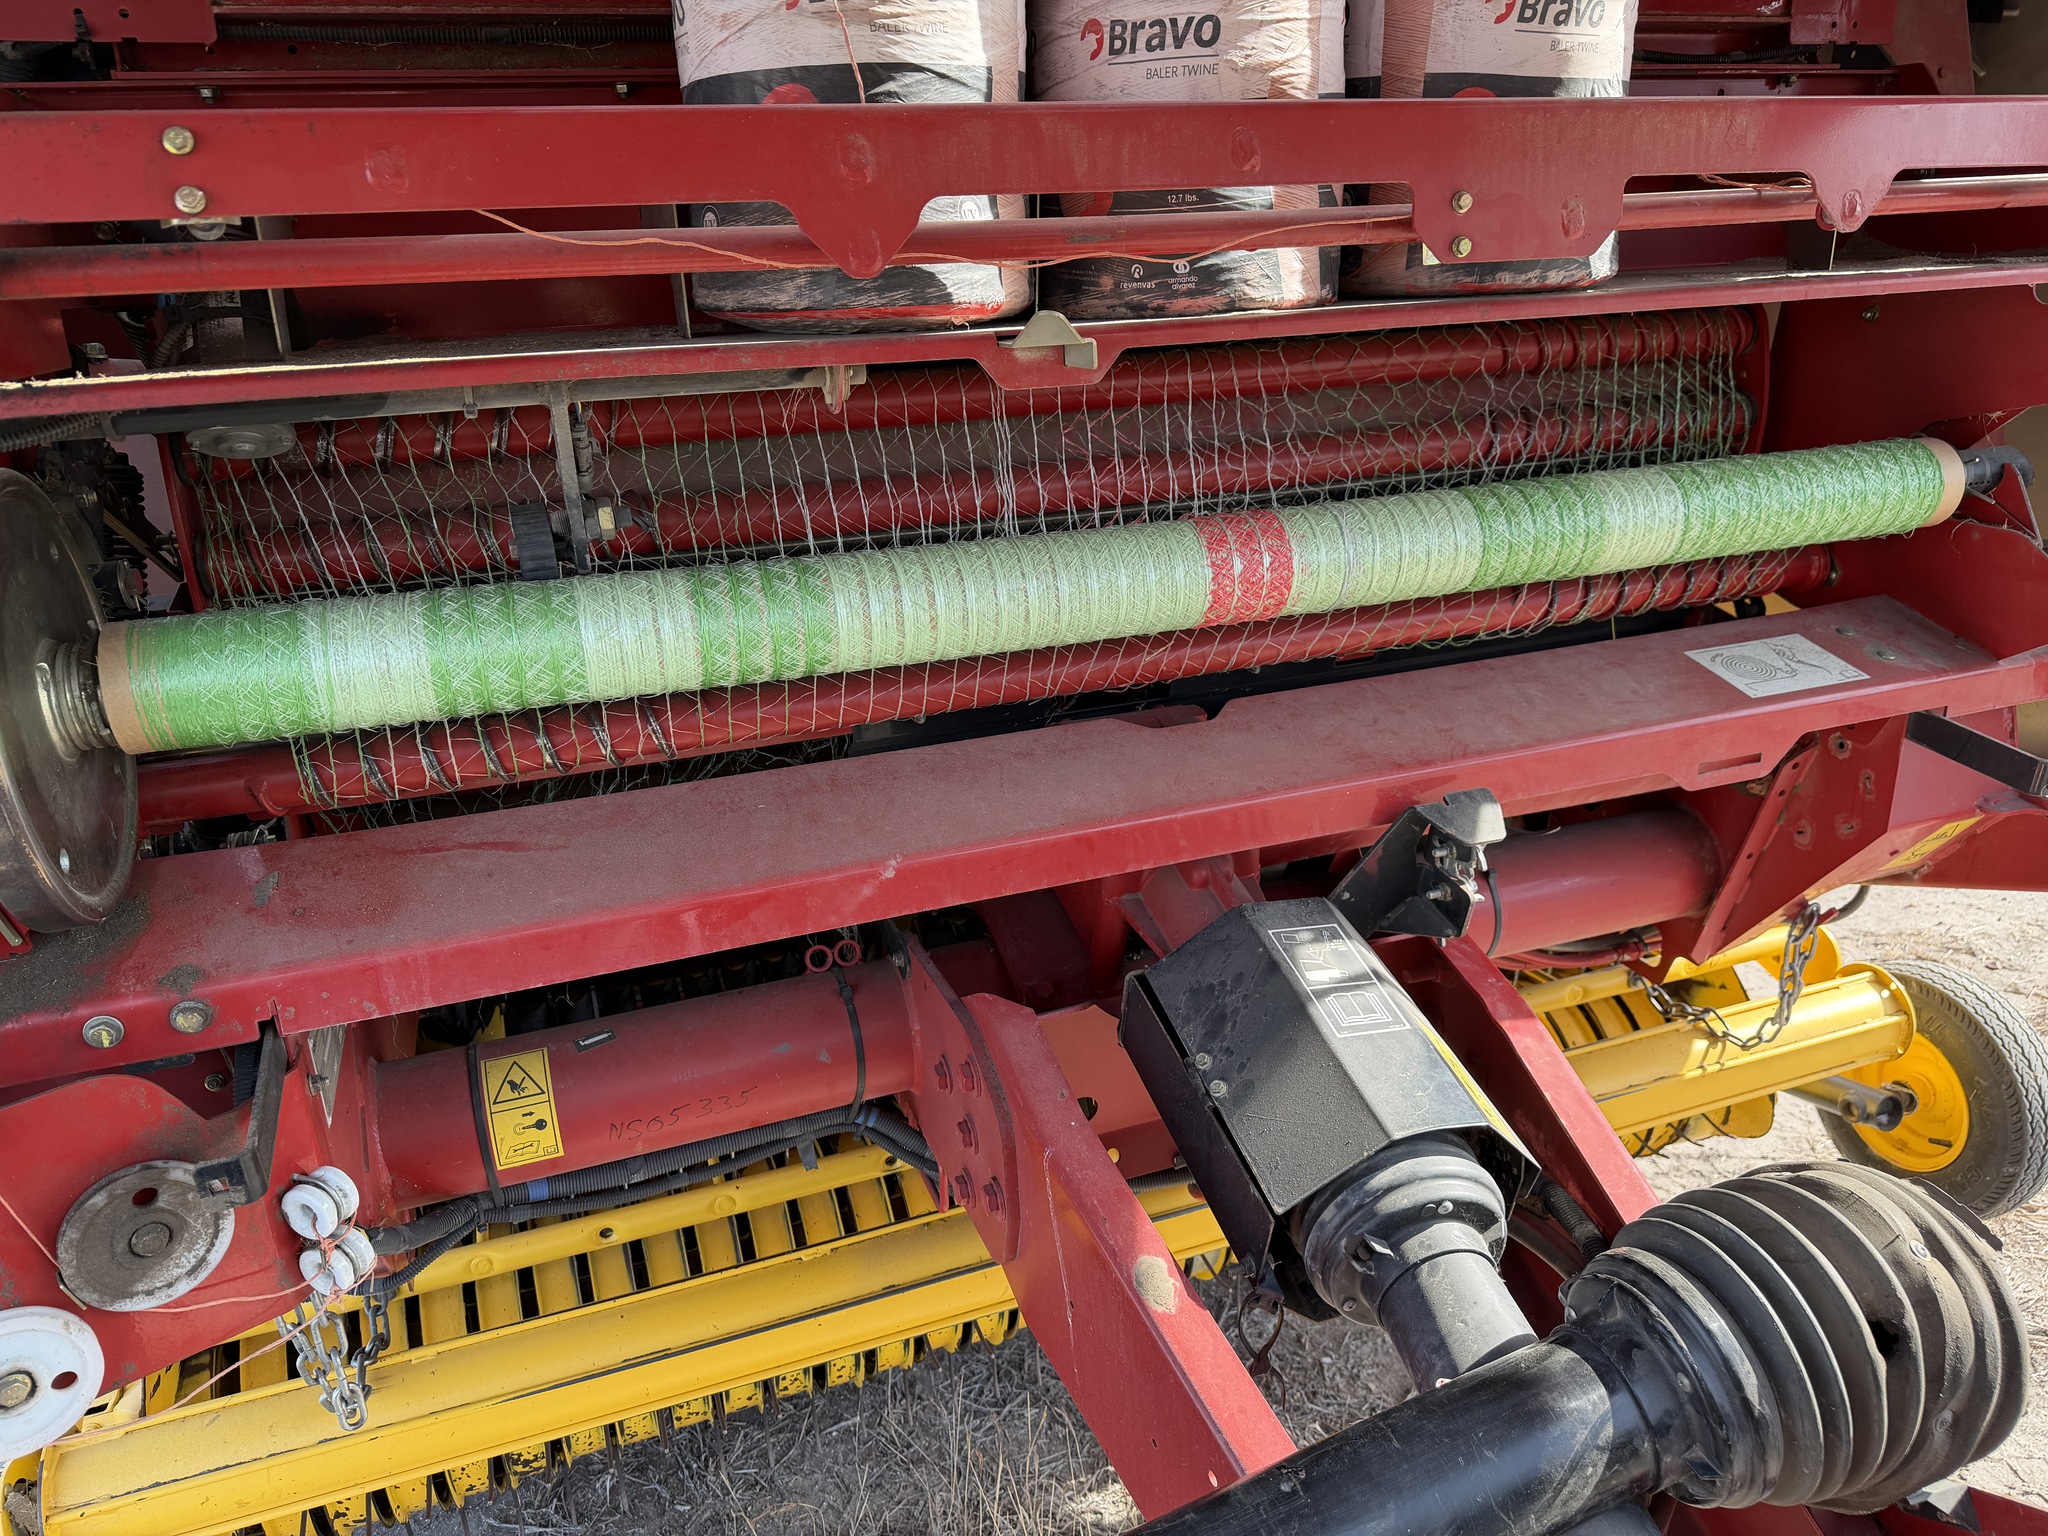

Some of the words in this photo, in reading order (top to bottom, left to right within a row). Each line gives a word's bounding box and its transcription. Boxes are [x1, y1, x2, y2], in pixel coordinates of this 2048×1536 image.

[1517, 0, 1606, 28] Bravo
[869, 21, 910, 33] BALER
[1108, 14, 1221, 56] Bravo
[1550, 40, 1575, 52] BALER
[1576, 41, 1600, 54] TWINE
[1146, 65, 1178, 80] BALER
[1182, 63, 1219, 77] TWINE
[1167, 194, 1183, 203] 12.7
[1185, 193, 1199, 202] lbs.
[1119, 281, 1156, 290] revenvas
[1168, 275, 1199, 284] armando
